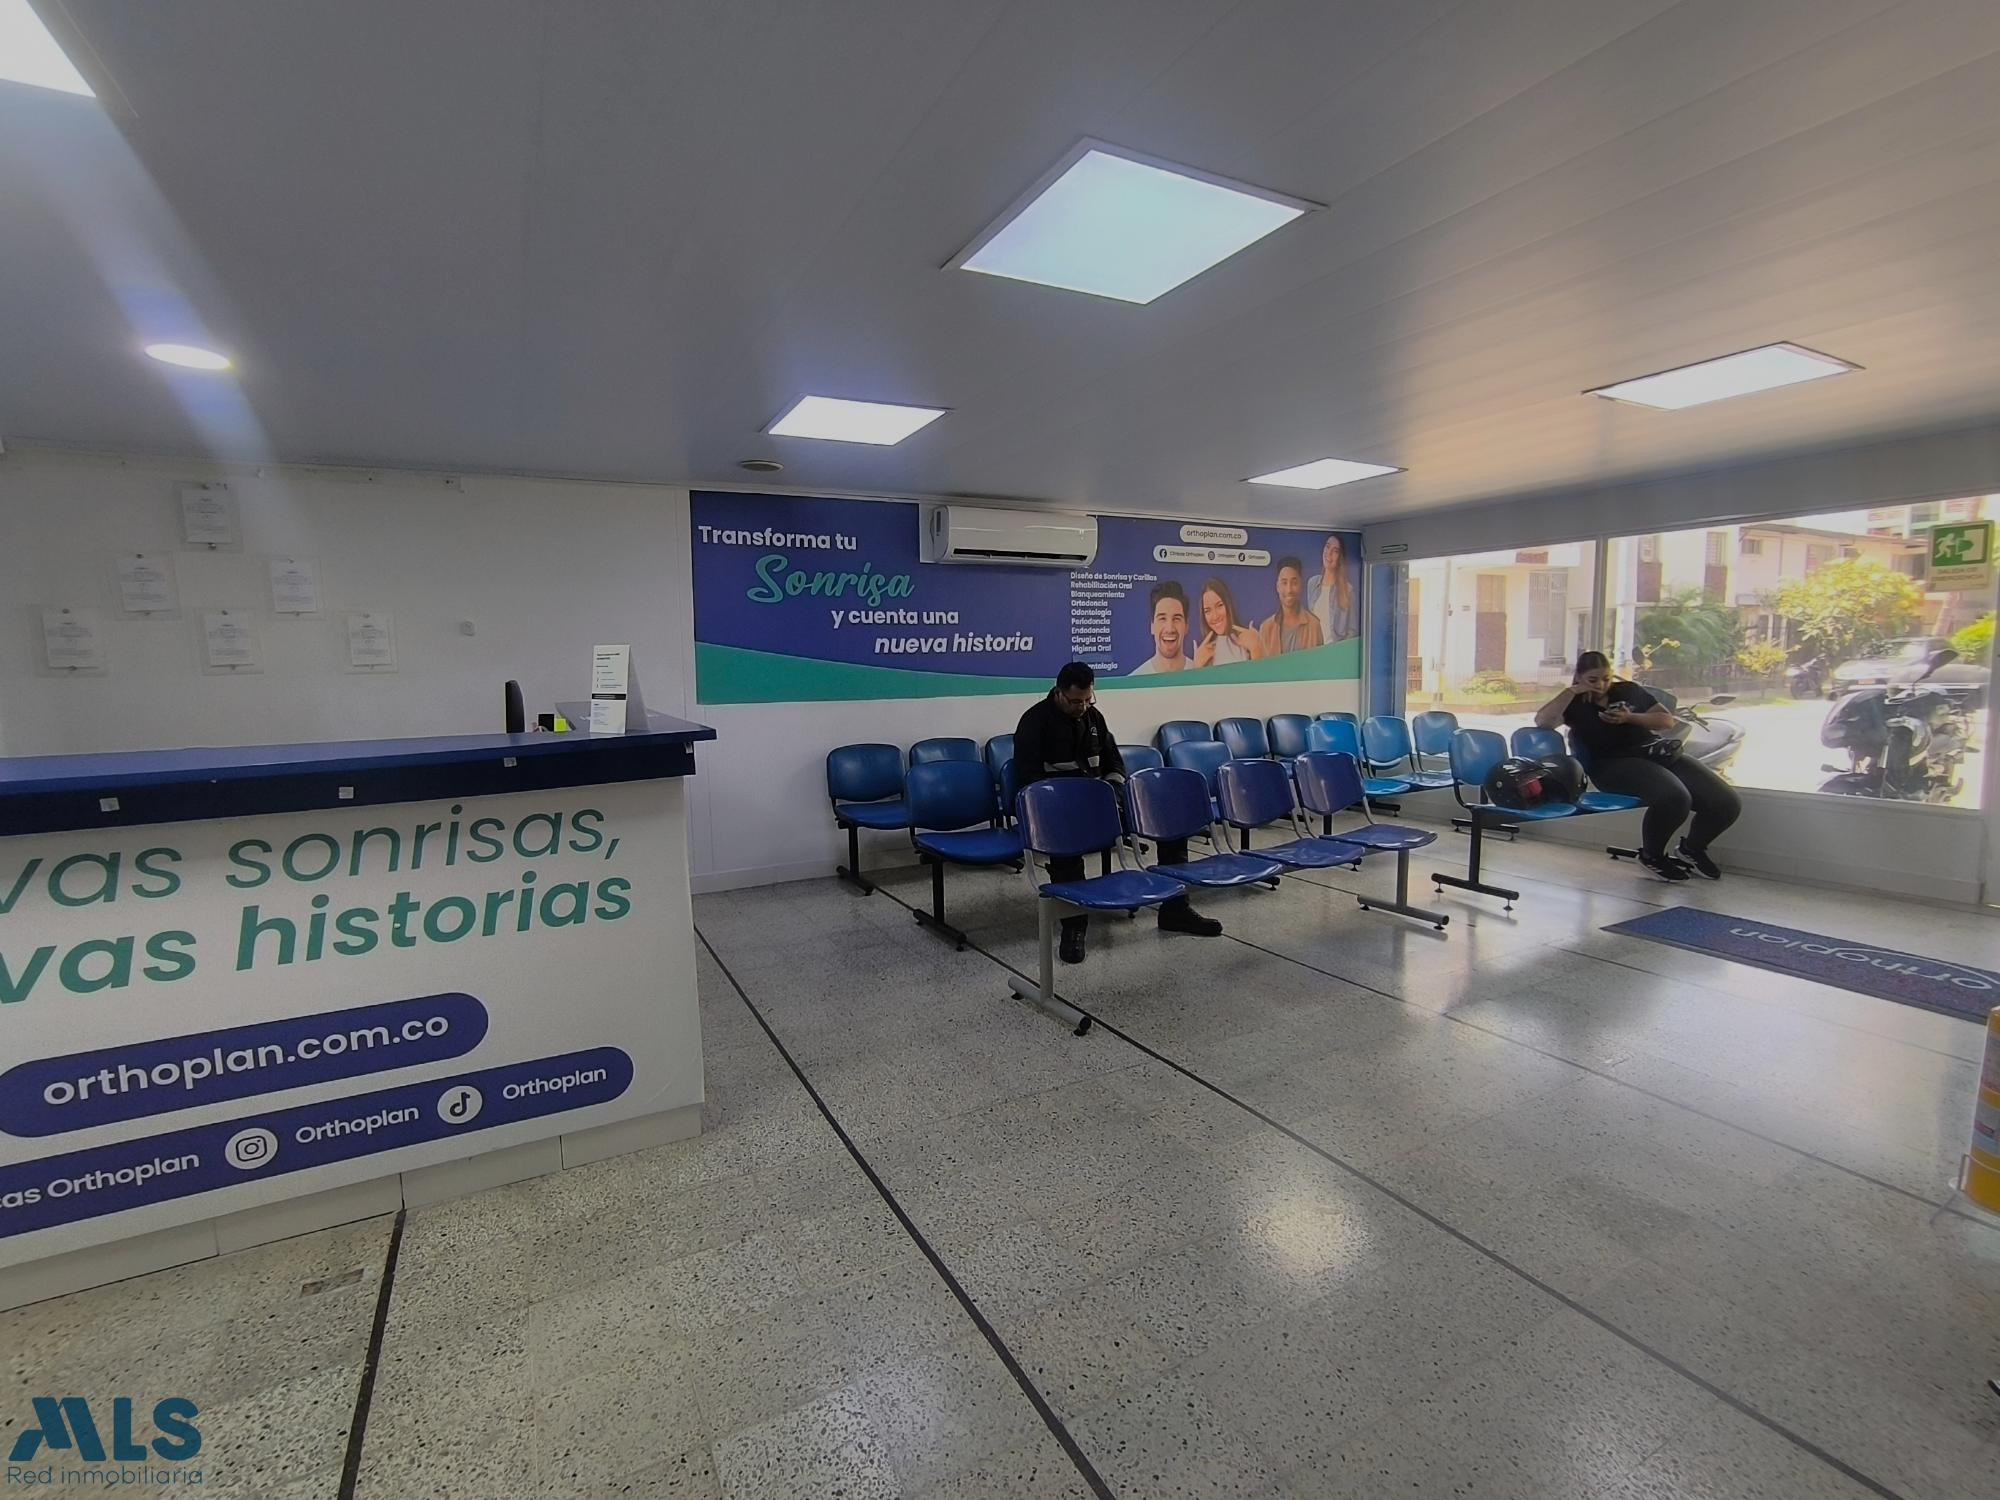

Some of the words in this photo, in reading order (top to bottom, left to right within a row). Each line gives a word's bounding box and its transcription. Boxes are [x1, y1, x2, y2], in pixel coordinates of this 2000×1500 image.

[698, 525, 831, 551] Transforma
[835, 532, 857, 551] tu
[1186, 530, 1242, 540] orthoplan.com.co
[746, 554, 915, 608] Sonrisa
[1070, 572, 1093, 580] Diseño
[1104, 573, 1128, 581] Sonrisa
[1071, 581, 1118, 589] Rehabilitación
[1071, 590, 1125, 599] Blanqueamiento
[1071, 599, 1108, 607] Ortodoncia
[832, 609, 844, 629] y
[848, 610, 918, 625] cuenta
[922, 610, 959, 625] una
[1072, 617, 1110, 625] Periodoncia
[1072, 626, 1110, 634] Endodoncia
[874, 635, 946, 654] nueva
[952, 632, 1034, 652] historia
[1072, 644, 1096, 654] Higiene
[1097, 644, 1112, 652] Oral
[225, 805, 621, 890] sonrisas,
[0, 930, 197, 1004] vas
[235, 871, 633, 972] historias
[1729, 928, 1992, 990] orthoplan
[43, 1015, 450, 1106] orthoplan.com.co
[502, 1065, 608, 1101] Orthoplan
[295, 1104, 420, 1146] Orthoplan
[47, 1154, 200, 1198] Orthoplan
